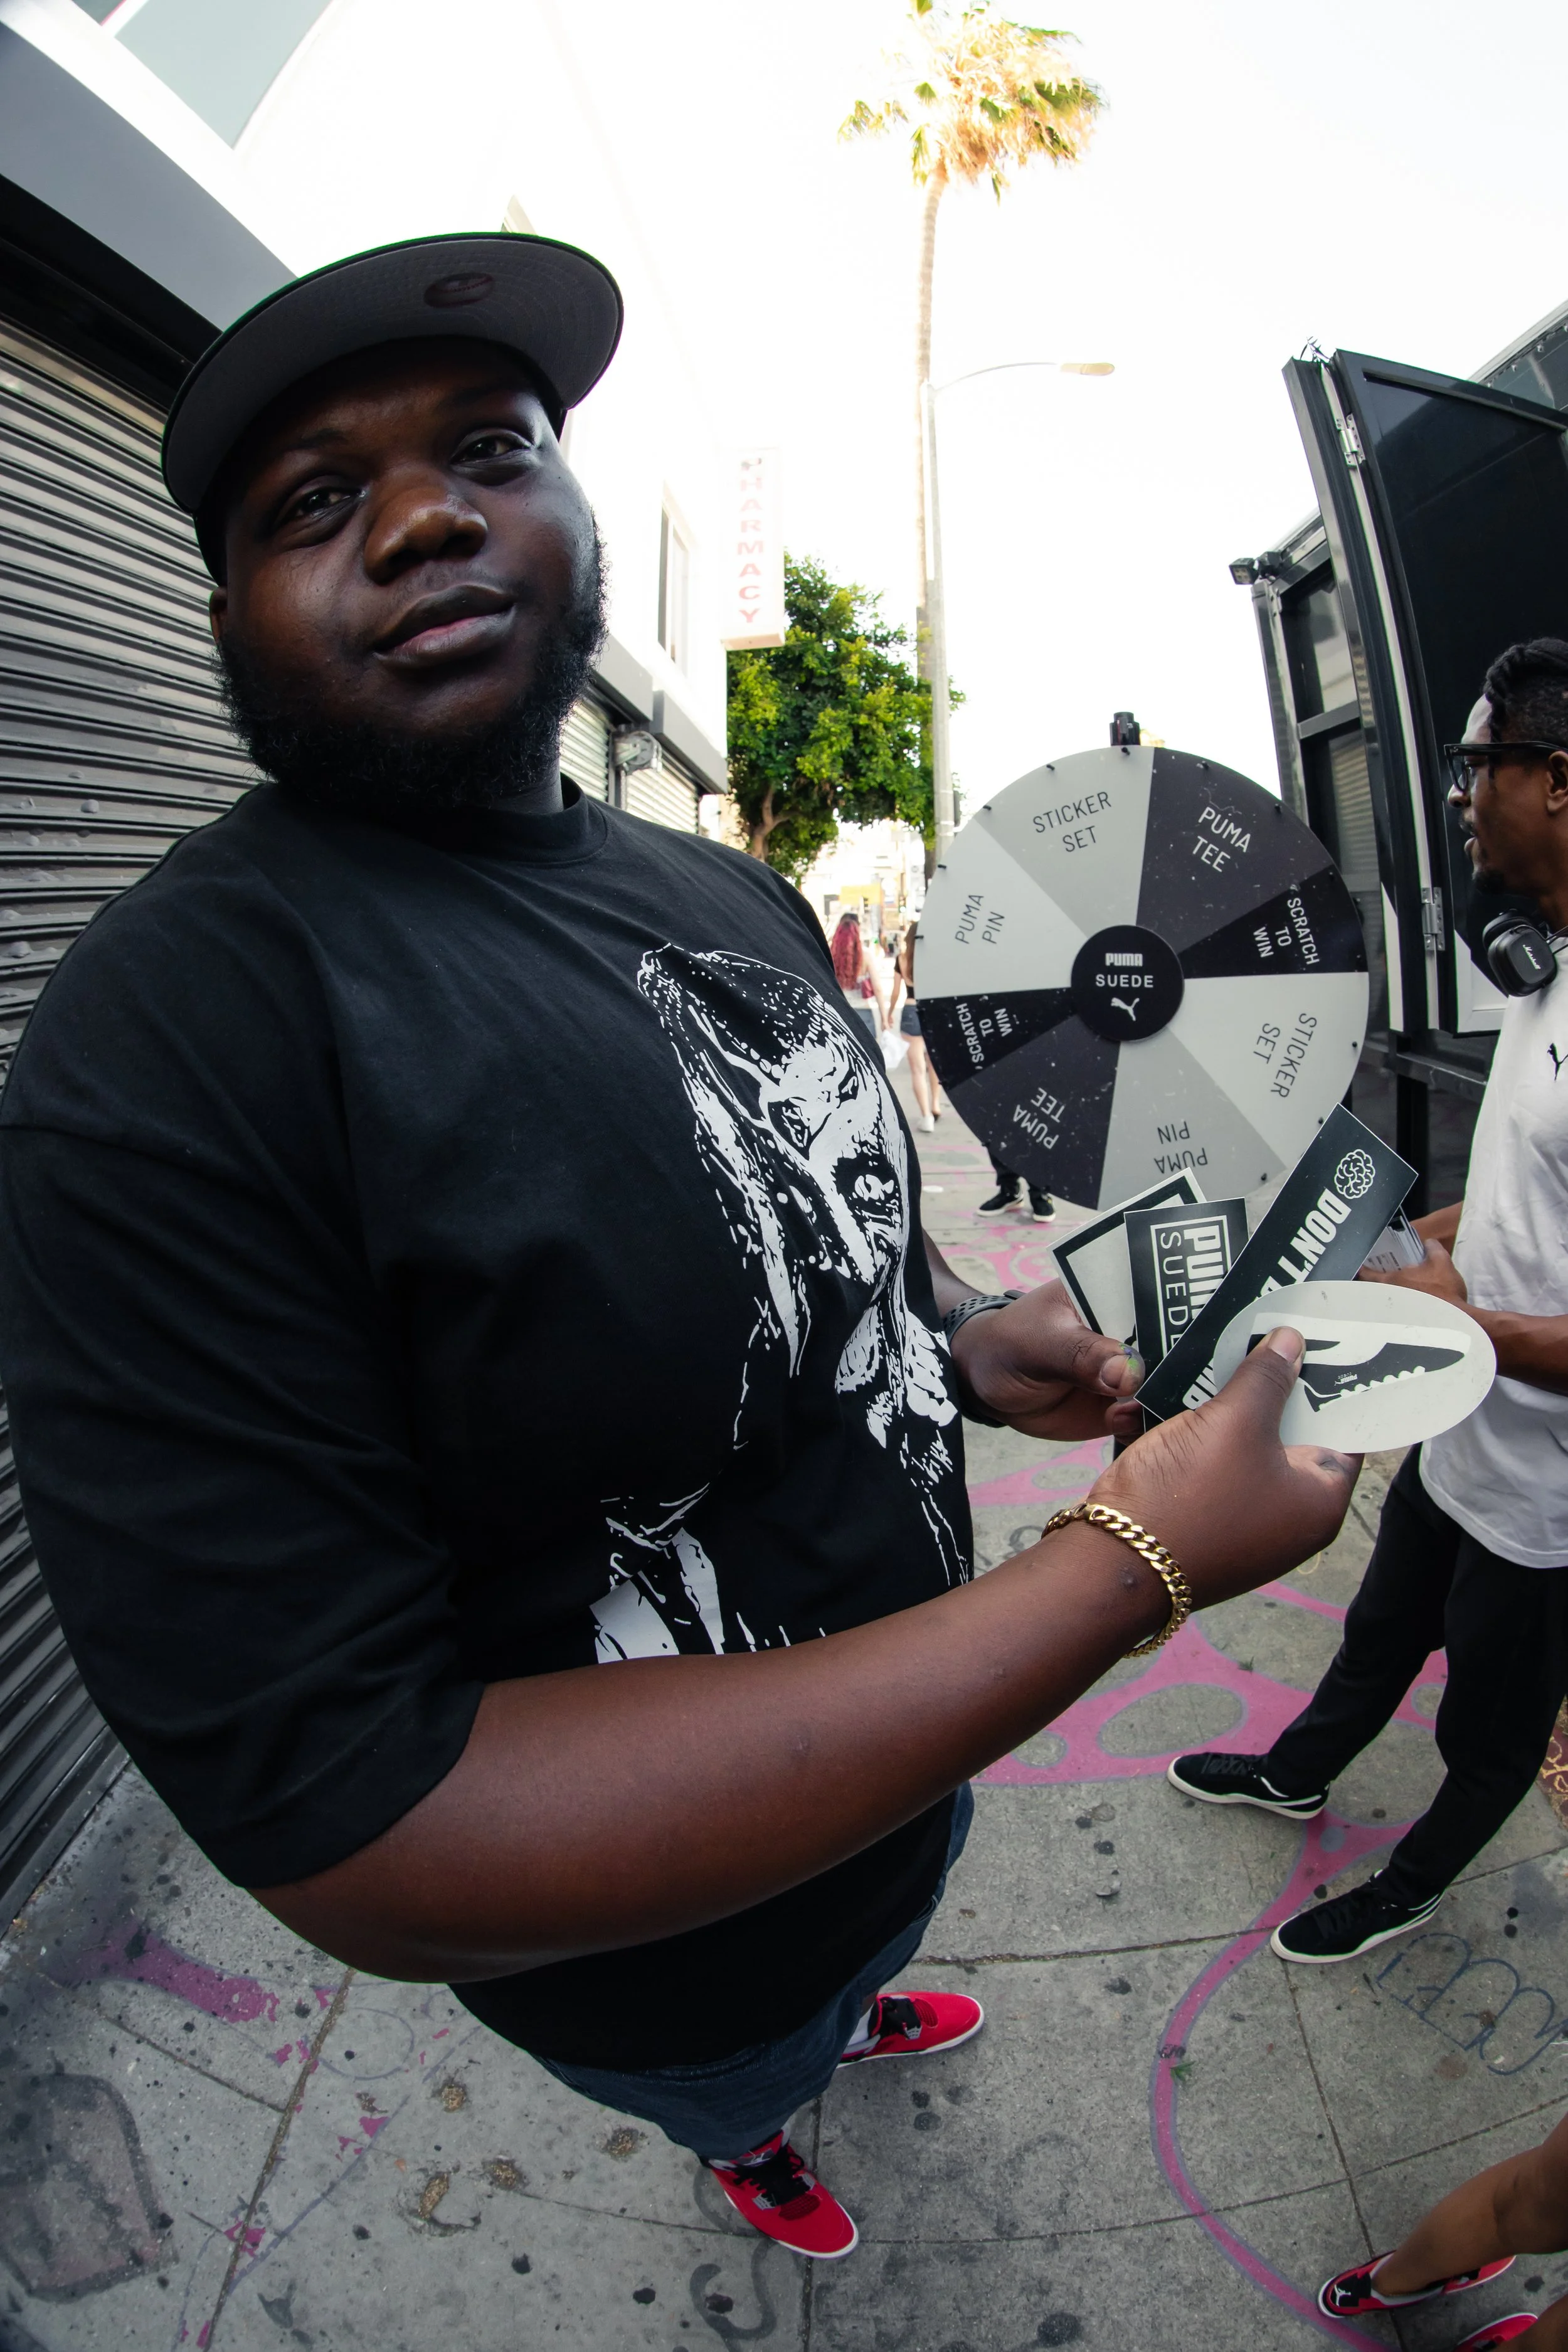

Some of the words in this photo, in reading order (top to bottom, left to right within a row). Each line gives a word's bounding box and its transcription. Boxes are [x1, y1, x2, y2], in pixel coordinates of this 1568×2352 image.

[1032, 791, 1112, 834] STICKER
[1198, 806, 1253, 852] PUMA
[1062, 825, 1098, 853] SET
[1191, 836, 1231, 872] TEE
[955, 894, 984, 945] PUMA
[982, 911, 1005, 944] PIN
[1274, 926, 1291, 947] TO
[1286, 897, 1320, 966] SCRATCH
[1253, 926, 1274, 959] WIN
[1523, 945, 1541, 970] Marshall
[1105, 953, 1143, 967] PUMA
[1095, 974, 1153, 988] SUEDE
[956, 1003, 985, 1063] SCRATCH
[979, 1019, 994, 1037] TO
[994, 1008, 1013, 1037] WIN
[1253, 1022, 1281, 1064] SET
[1270, 1012, 1317, 1099] STICKER
[1030, 1087, 1066, 1123] TEE
[1012, 1103, 1059, 1149] PUMA
[1158, 1120, 1190, 1145] PIN
[1153, 1147, 1208, 1174] PUMA
[1277, 1188, 1352, 1284] DON'T
